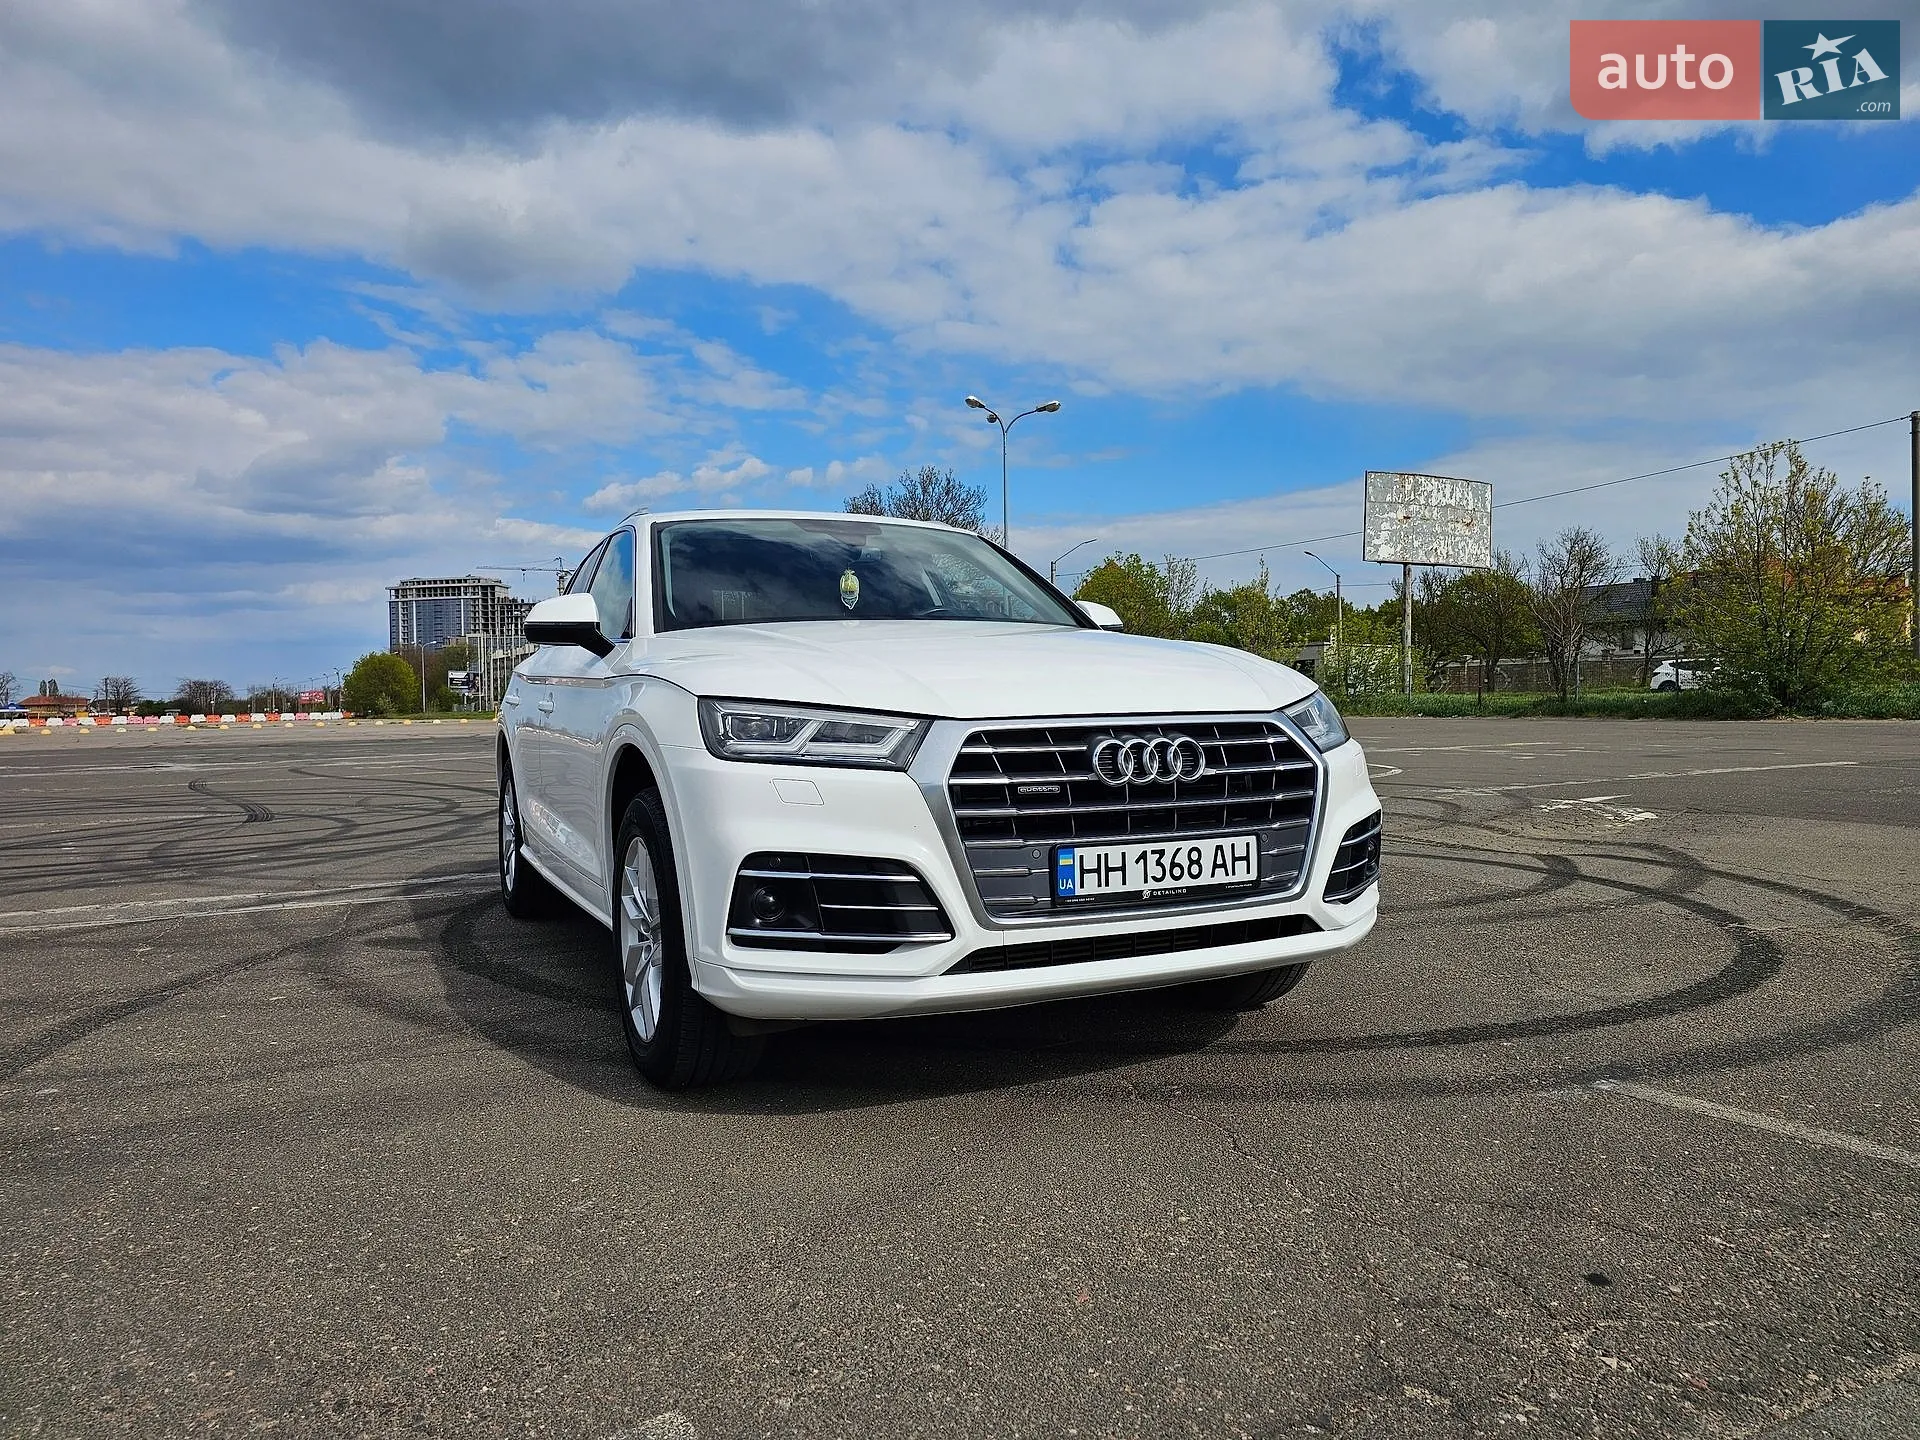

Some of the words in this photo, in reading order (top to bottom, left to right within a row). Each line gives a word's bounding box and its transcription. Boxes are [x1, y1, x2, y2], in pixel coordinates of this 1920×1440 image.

[1079, 851, 1127, 889] HH
[1134, 846, 1202, 884] 1368
[1210, 841, 1251, 878] AH
[1059, 878, 1074, 890] UA
